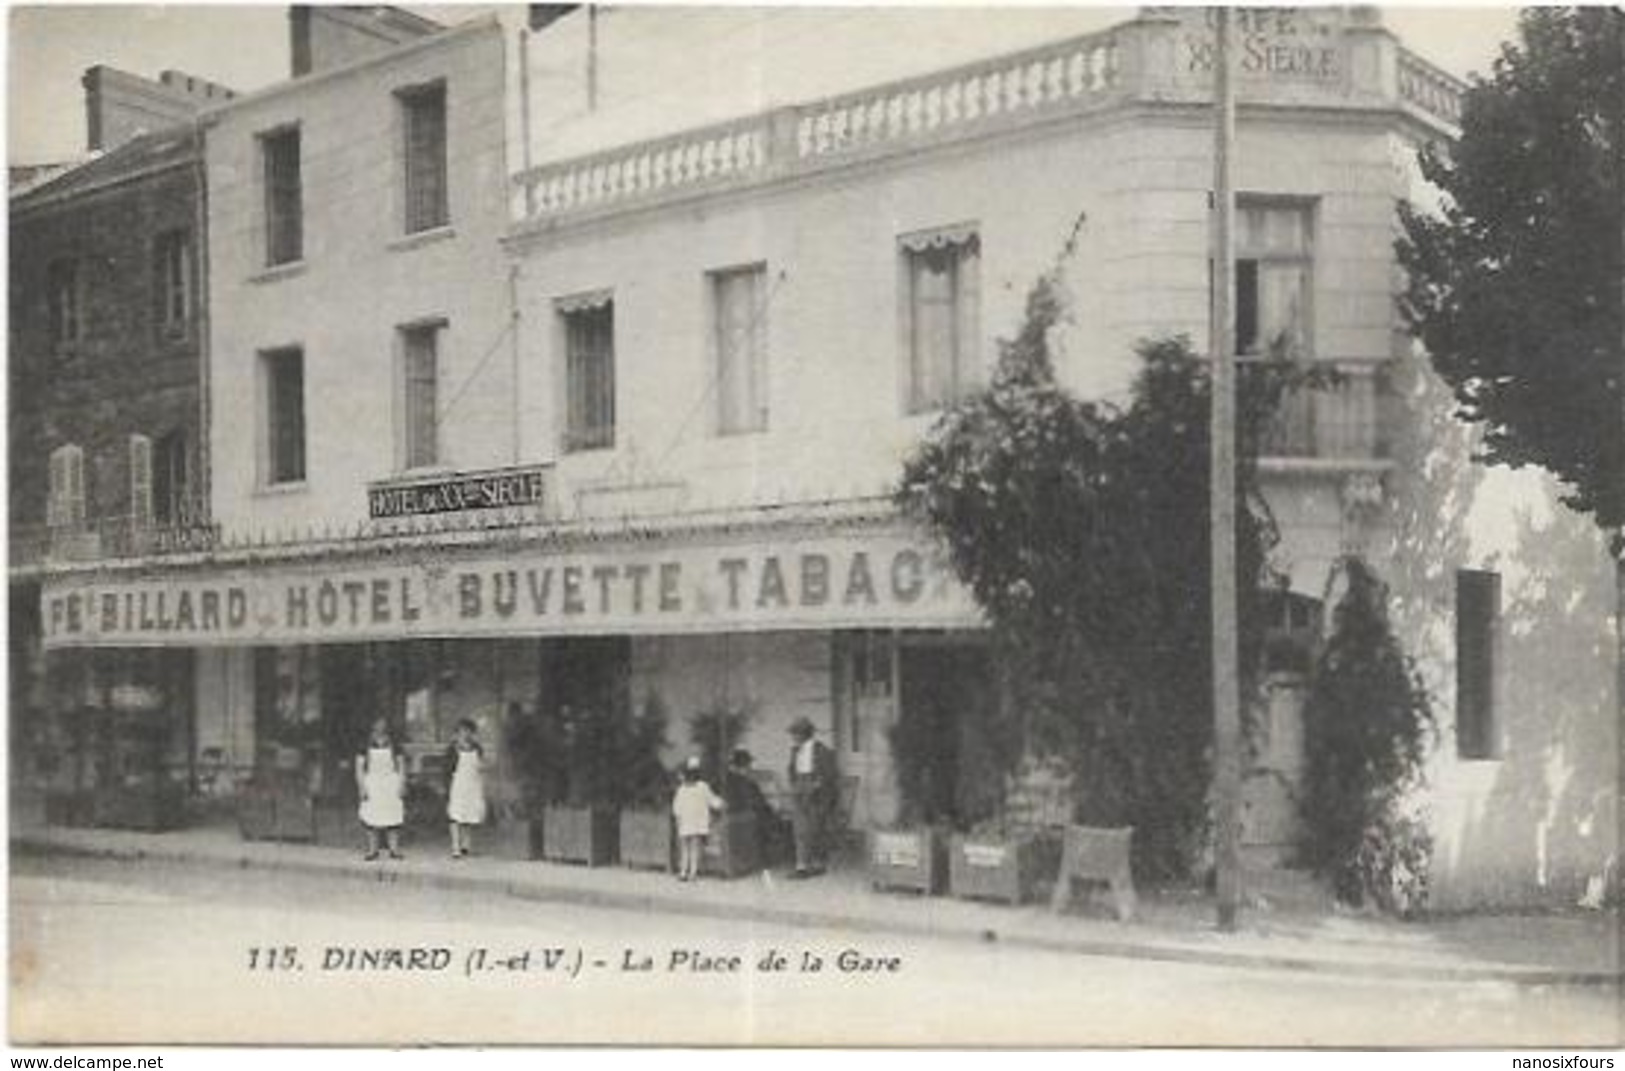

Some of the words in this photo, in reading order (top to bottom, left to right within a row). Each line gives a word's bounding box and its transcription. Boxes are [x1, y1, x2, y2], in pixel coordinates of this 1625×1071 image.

[101, 587, 247, 632] BILLARD
[286, 577, 421, 627] HÔTEL
[459, 561, 682, 619] BUVETTE
[718, 550, 925, 611] TABAC
